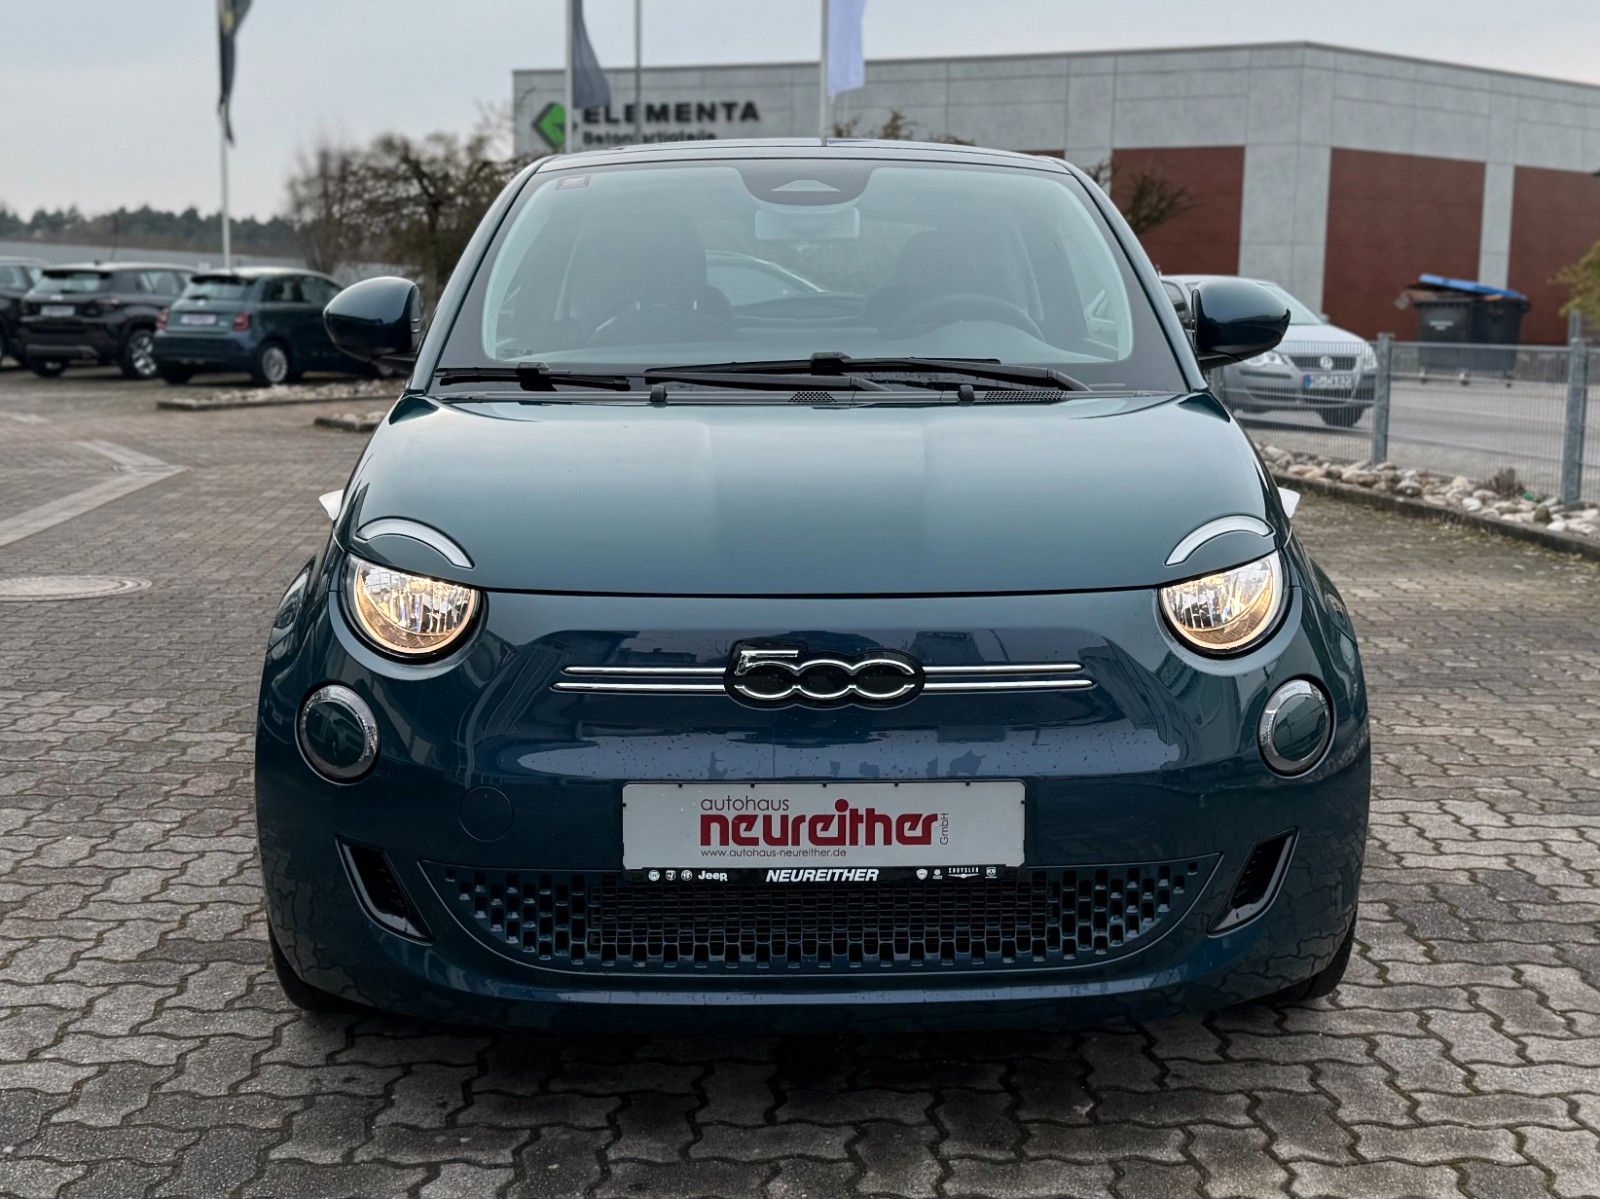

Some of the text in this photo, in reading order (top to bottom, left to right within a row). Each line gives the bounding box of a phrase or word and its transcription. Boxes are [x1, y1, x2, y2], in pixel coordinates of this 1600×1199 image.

[582, 102, 760, 124] ELEMENTA
[734, 650, 915, 699] 500
[700, 795, 790, 812] autohaus
[700, 798, 938, 846] neureither
[939, 812, 949, 846] GmbH
[700, 848, 847, 858] www.autohaus-neureither.de
[698, 870, 728, 882] Jeep
[765, 868, 880, 883] NEUREITHER
